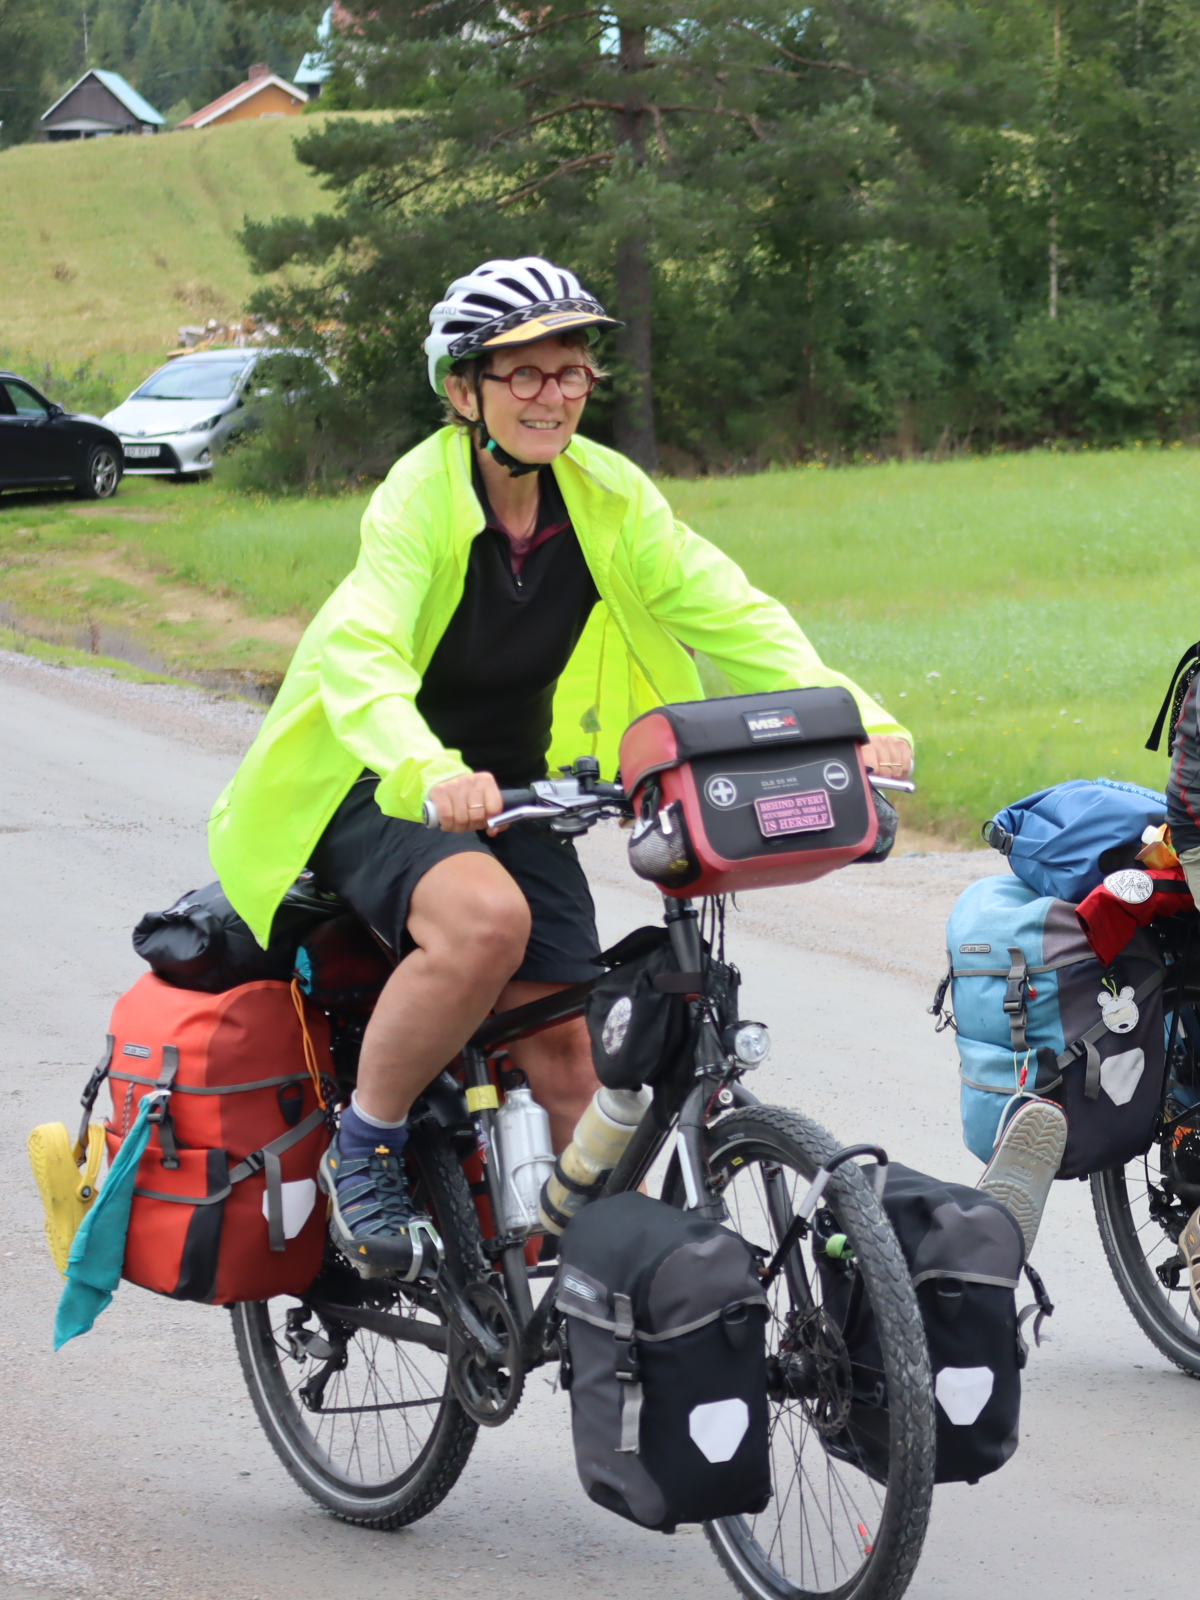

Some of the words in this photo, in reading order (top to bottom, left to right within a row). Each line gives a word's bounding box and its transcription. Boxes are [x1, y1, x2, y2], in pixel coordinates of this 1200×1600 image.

[748, 716, 798, 731] MS-X
[760, 799, 795, 812] BEHIND
[795, 794, 824, 807] EVERY
[762, 808, 802, 820] SUCCESSFUL
[802, 804, 827, 814] WOMAN
[764, 820, 778, 832] IS
[778, 813, 828, 830] HERSELF
